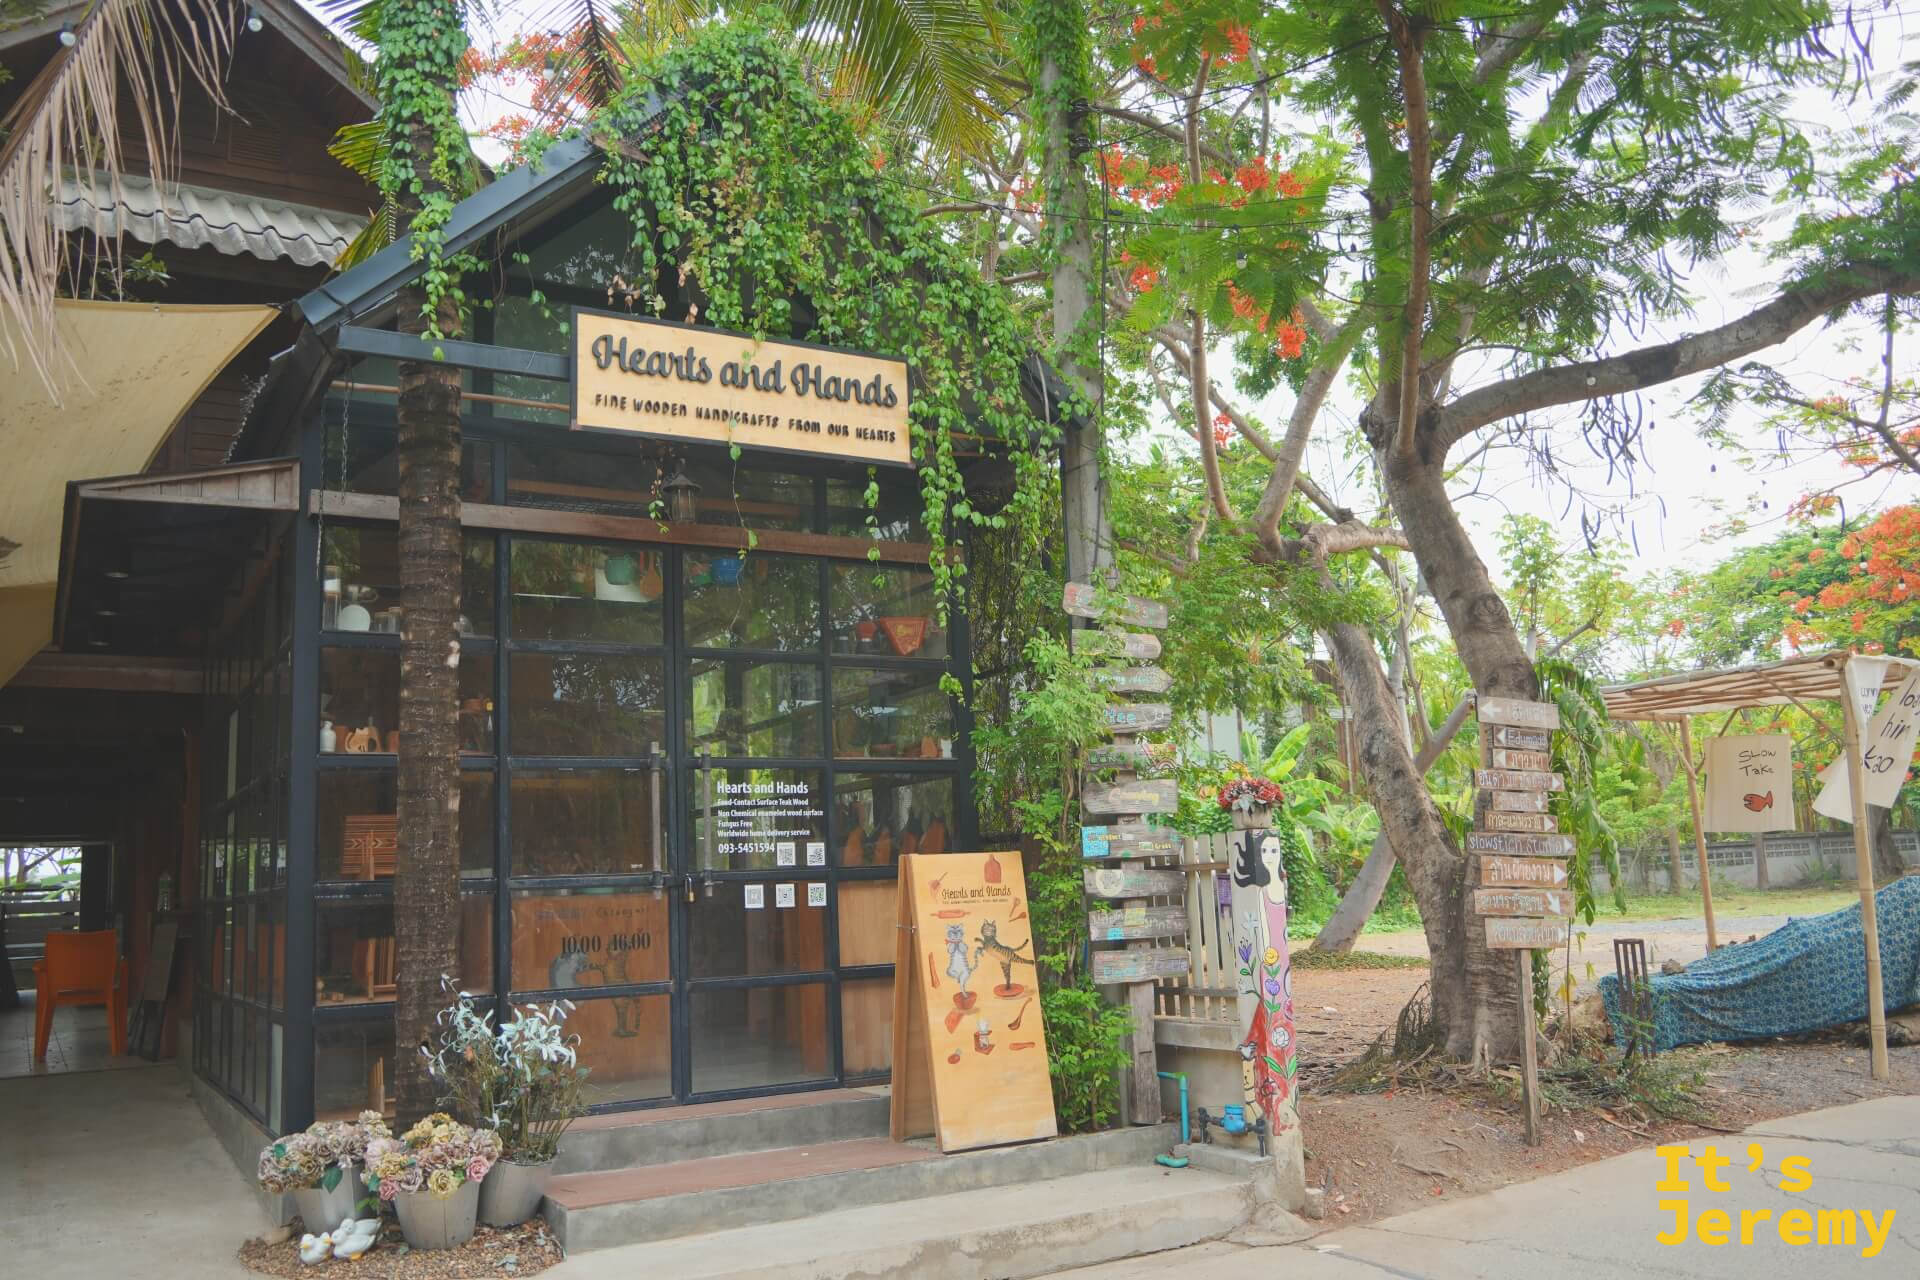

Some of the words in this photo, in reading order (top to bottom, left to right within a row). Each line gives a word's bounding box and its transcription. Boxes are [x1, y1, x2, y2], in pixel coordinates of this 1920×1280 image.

[591, 334, 712, 383] Hearts
[720, 360, 786, 394] and
[790, 362, 898, 409] Hands
[788, 418, 821, 434] FROM
[827, 423, 849, 437] OUR
[856, 426, 896, 443] HEARTS
[717, 781, 752, 794] Hearts
[756, 782, 774, 794] and
[776, 781, 809, 794] Hands
[756, 798, 779, 806] Surface
[779, 798, 792, 806] Teak
[792, 798, 809, 806] Wood
[718, 809, 730, 817] Non
[731, 809, 757, 817] Chemical
[787, 808, 802, 816] wood
[803, 808, 824, 816] surface
[718, 820, 739, 828] Fungus
[767, 829, 789, 837] delivery
[718, 843, 775, 854] 093-5451594
[941, 886, 968, 899] Hearts
[970, 887, 985, 898] and
[986, 884, 1012, 897] Hands
